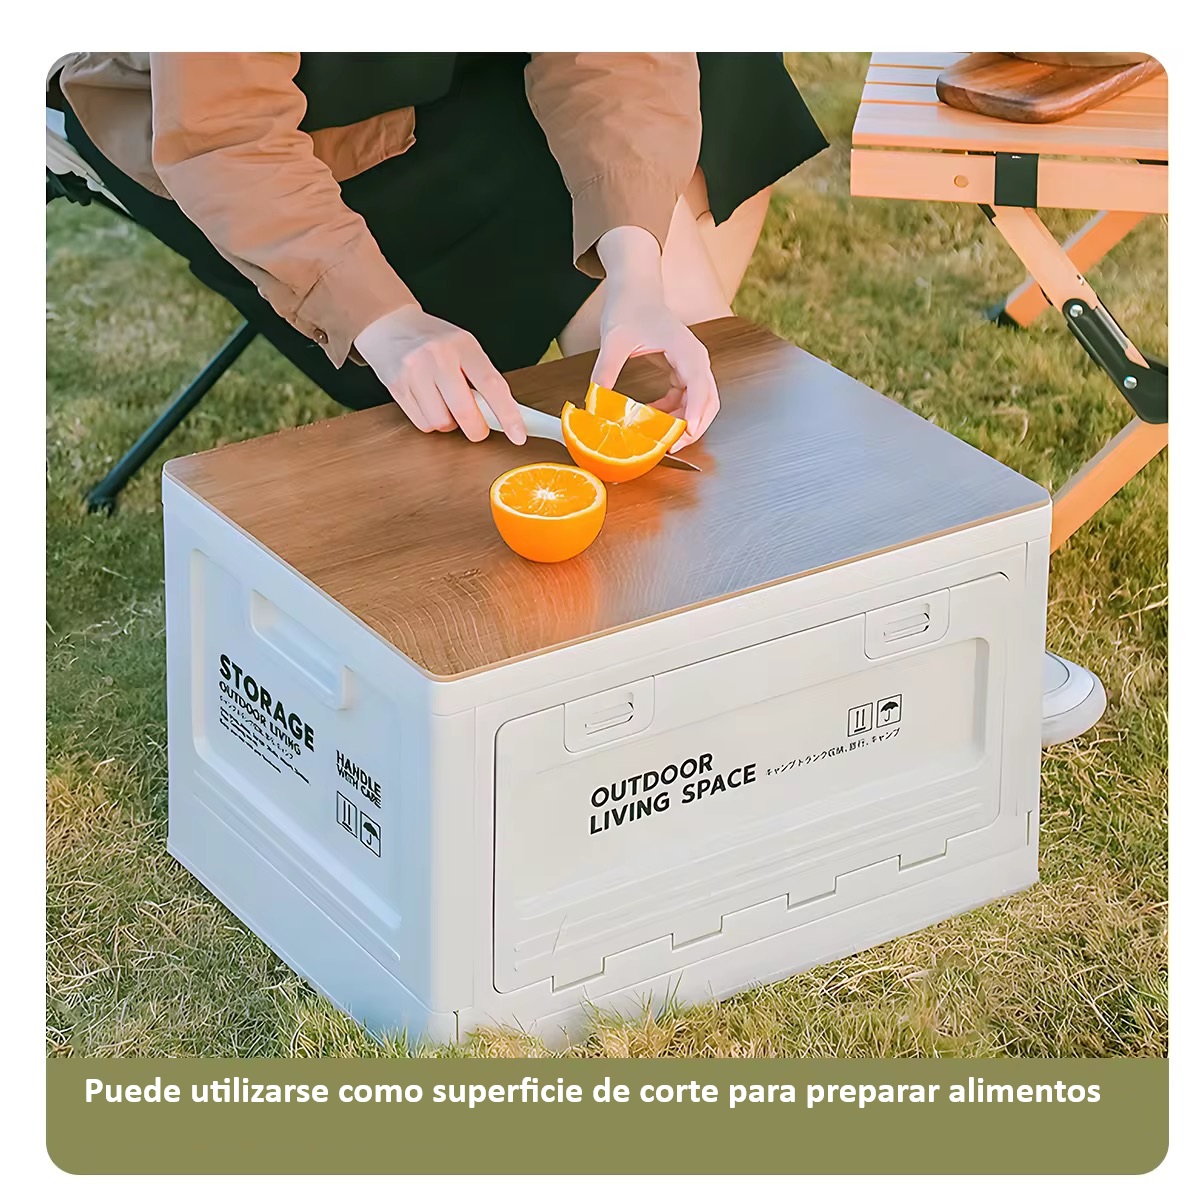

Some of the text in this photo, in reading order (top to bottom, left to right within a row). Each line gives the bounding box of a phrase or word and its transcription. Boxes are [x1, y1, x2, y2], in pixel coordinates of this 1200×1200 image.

[218, 653, 316, 753] STORAGE
[218, 681, 268, 728] OUTDOOR
[269, 721, 302, 756] LIVING
[336, 749, 382, 795] HANDLE
[589, 763, 757, 835] LIVING SPACE
[590, 753, 714, 808] OUTDOOR
